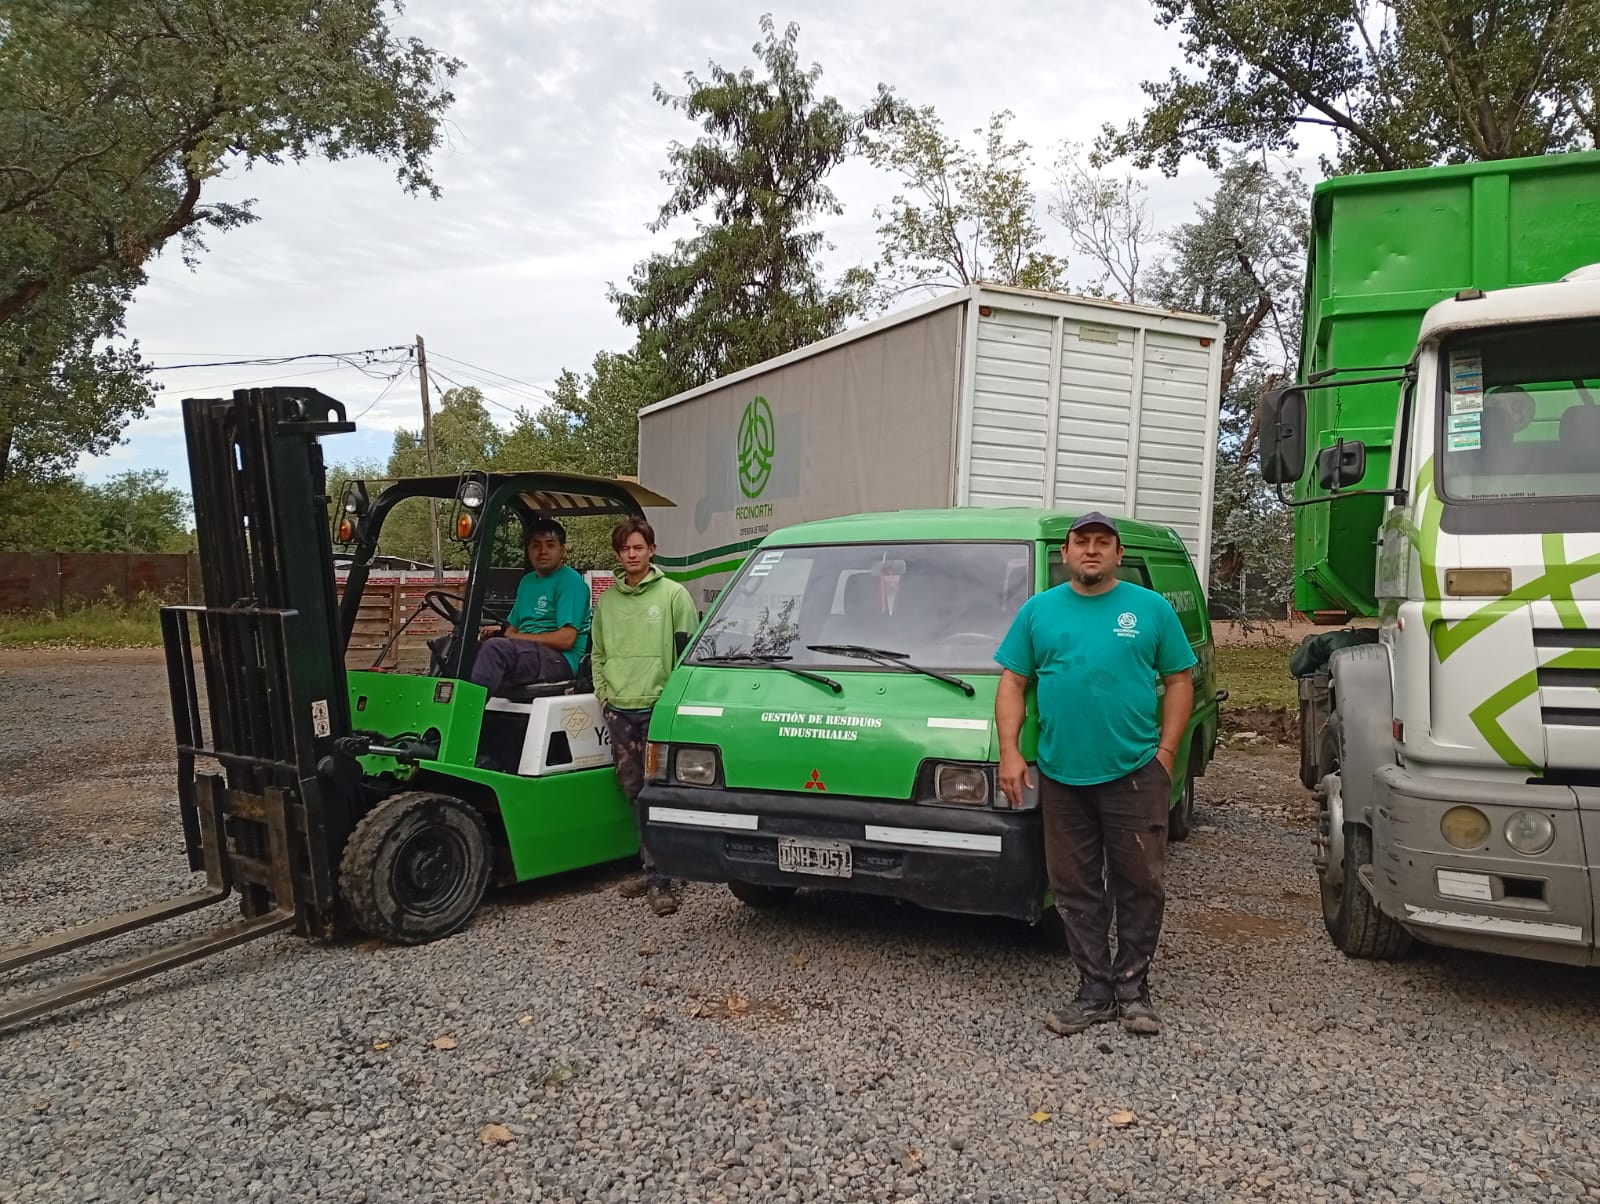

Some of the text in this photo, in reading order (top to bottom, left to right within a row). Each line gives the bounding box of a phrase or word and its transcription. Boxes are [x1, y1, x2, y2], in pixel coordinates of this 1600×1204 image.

[761, 711, 882, 728] GESTIÓN DE RESIDUOS
[778, 726, 858, 741] INDUSTRIALES
